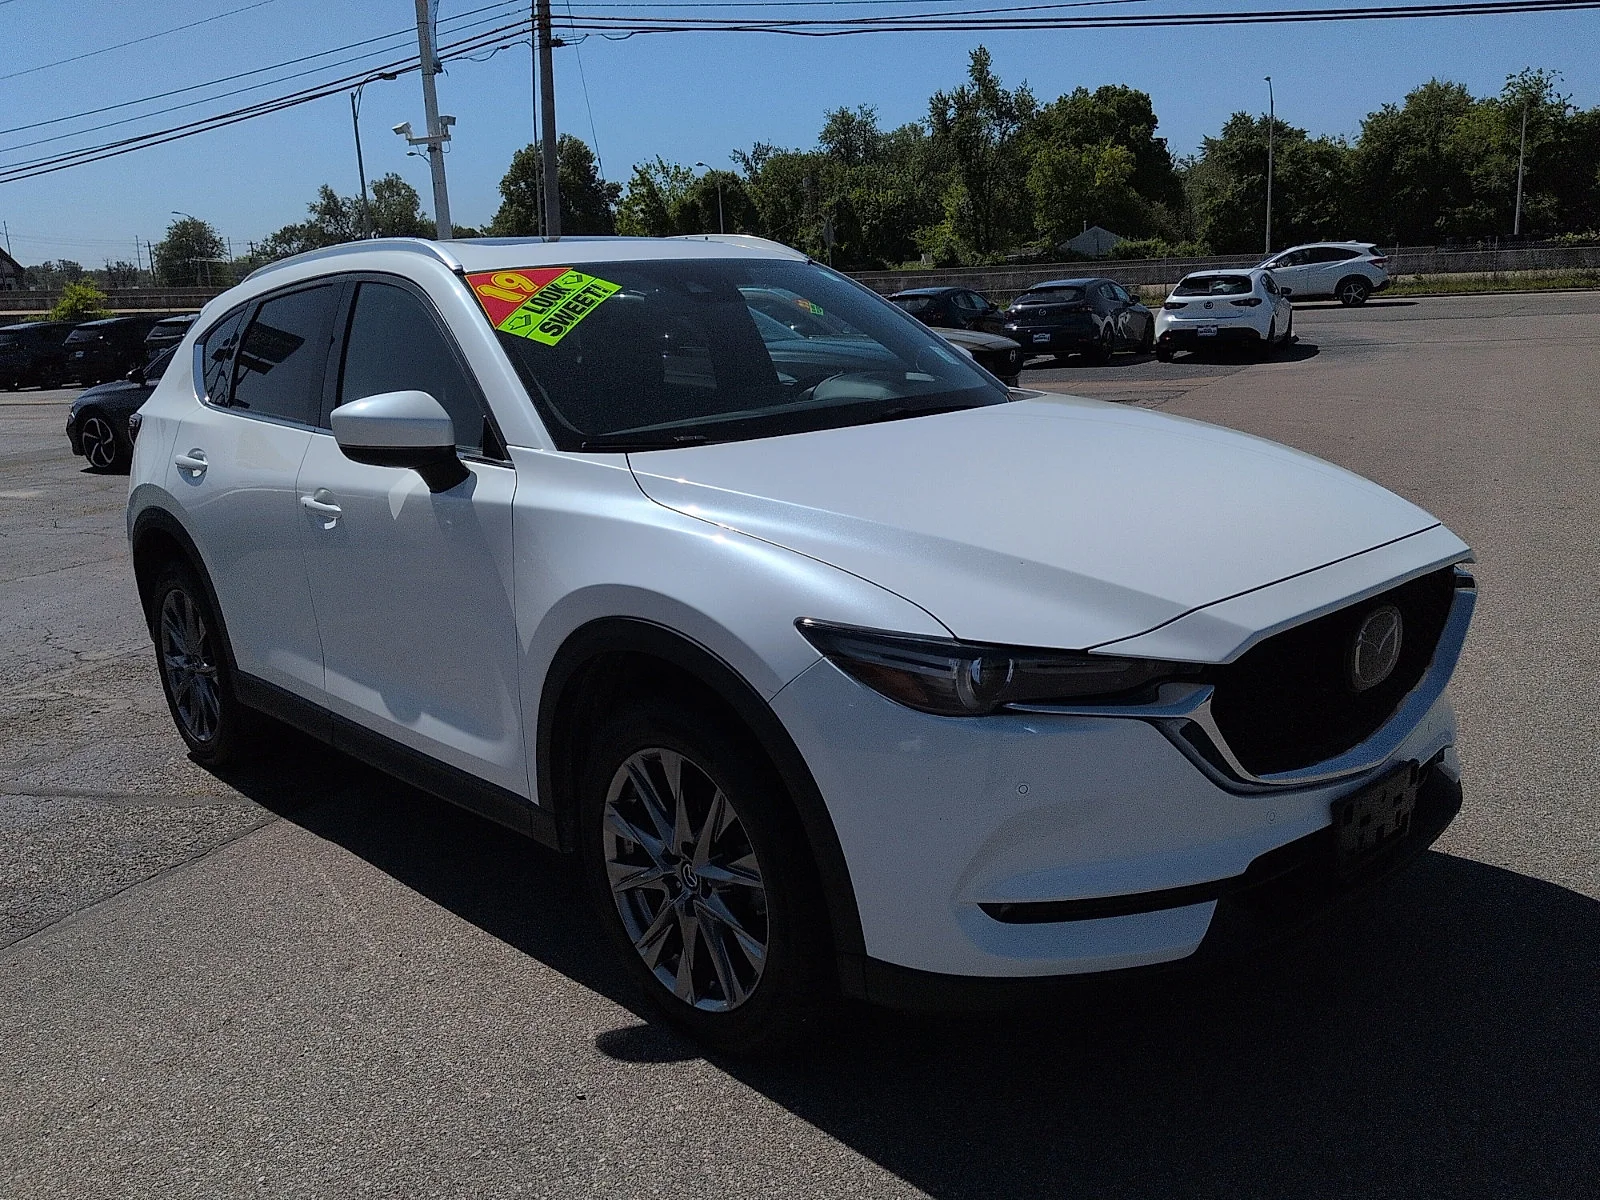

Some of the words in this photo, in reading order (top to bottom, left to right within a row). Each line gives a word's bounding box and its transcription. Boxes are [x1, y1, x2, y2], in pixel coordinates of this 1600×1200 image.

[476, 272, 539, 302] 19
[522, 283, 575, 316] LOOK
[538, 283, 613, 337] SWEET!
